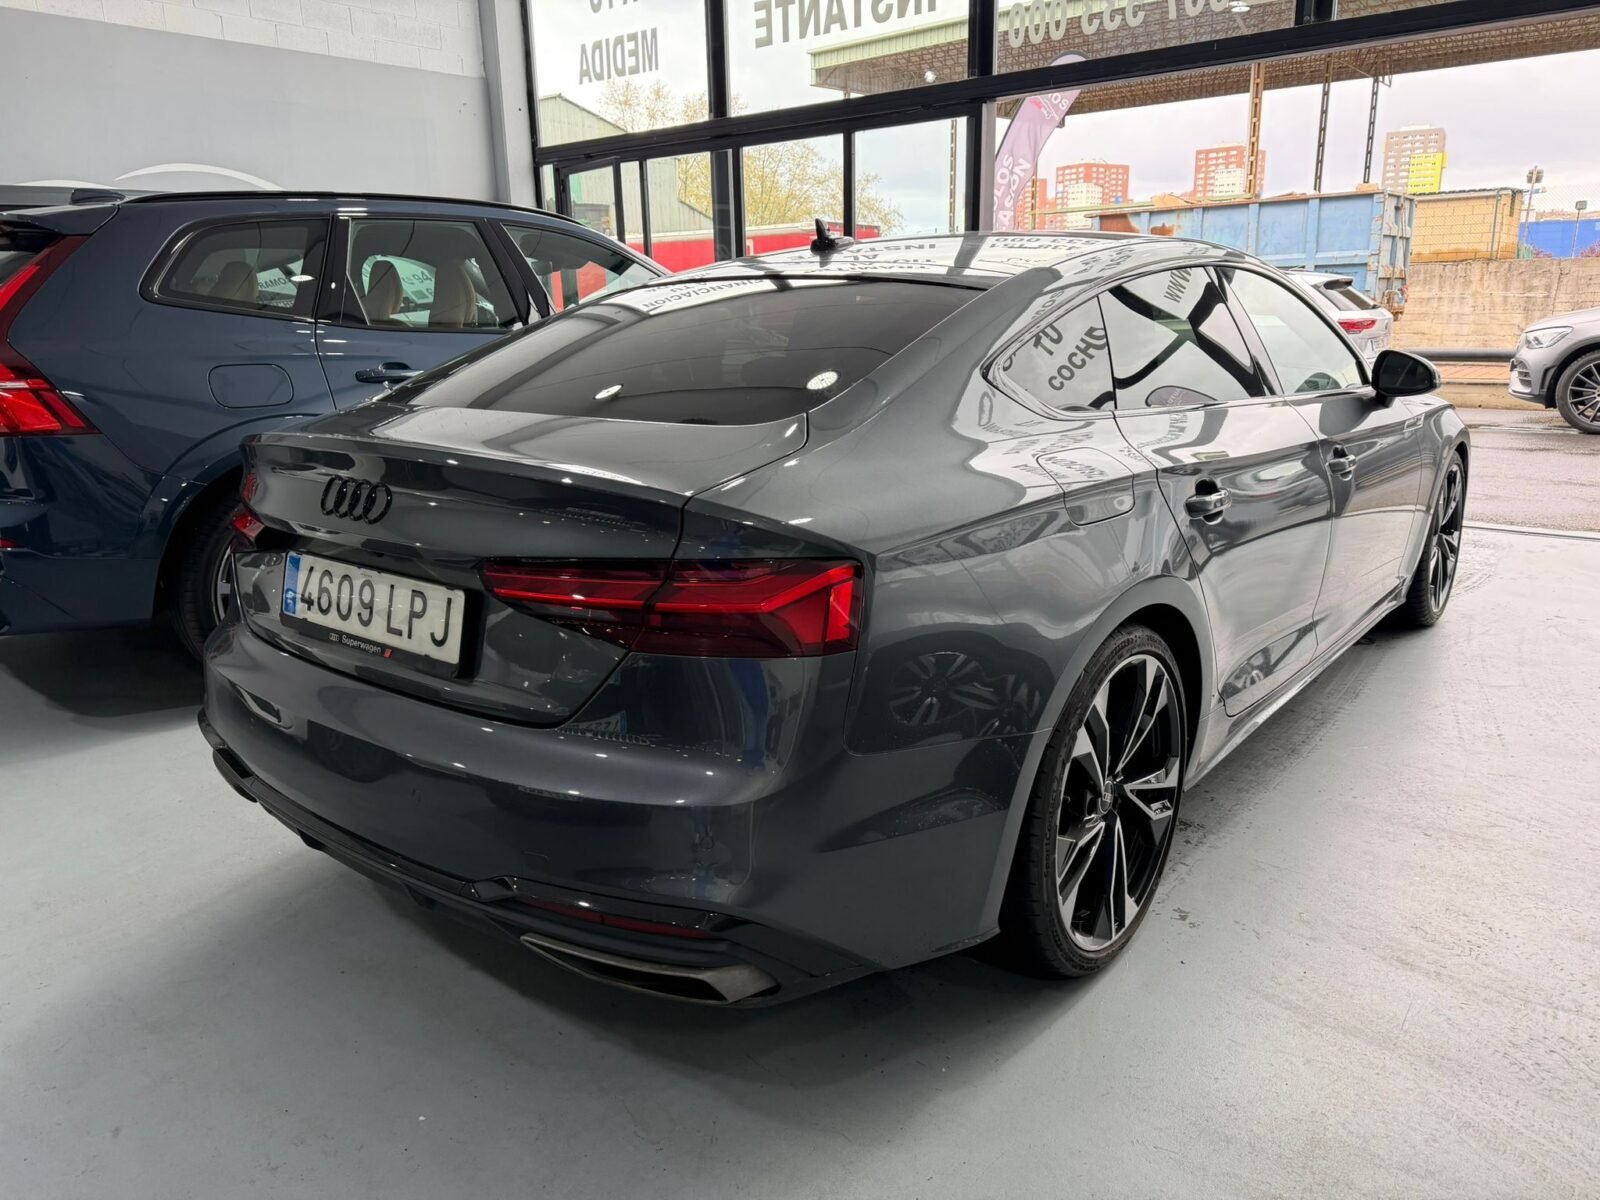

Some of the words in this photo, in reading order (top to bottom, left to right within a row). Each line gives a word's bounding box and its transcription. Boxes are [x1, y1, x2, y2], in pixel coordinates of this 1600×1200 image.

[1033, 324, 1064, 356] TU
[300, 566, 375, 627] 4609
[386, 584, 452, 647] LPJ
[342, 634, 382, 653] Superwagen
